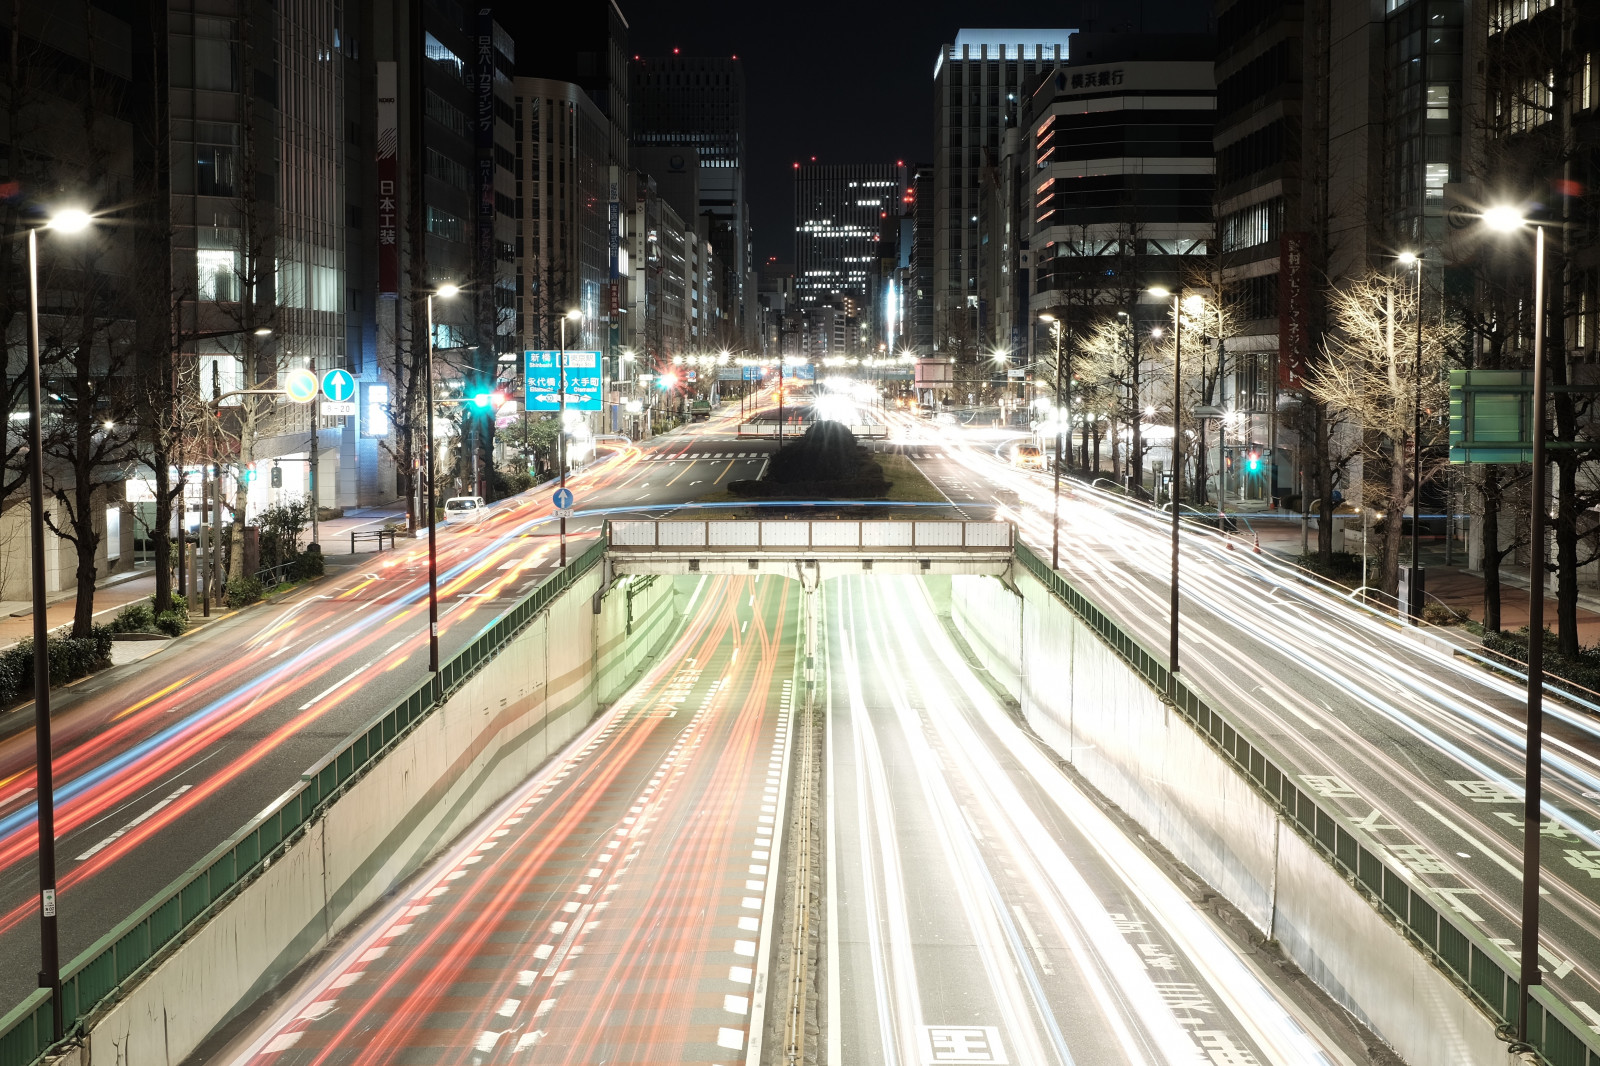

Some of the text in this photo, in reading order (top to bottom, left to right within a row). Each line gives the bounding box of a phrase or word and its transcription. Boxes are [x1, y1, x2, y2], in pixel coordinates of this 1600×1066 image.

[478, 35, 492, 132] 日本パーカライジング
[1071, 70, 1125, 89] 横浜銀行
[380, 180, 396, 245] 日本工装
[530, 353, 552, 362] 新橋
[528, 377, 556, 387] 永代橋
[571, 377, 600, 387] 大手町
[327, 405, 350, 413] 8-20
